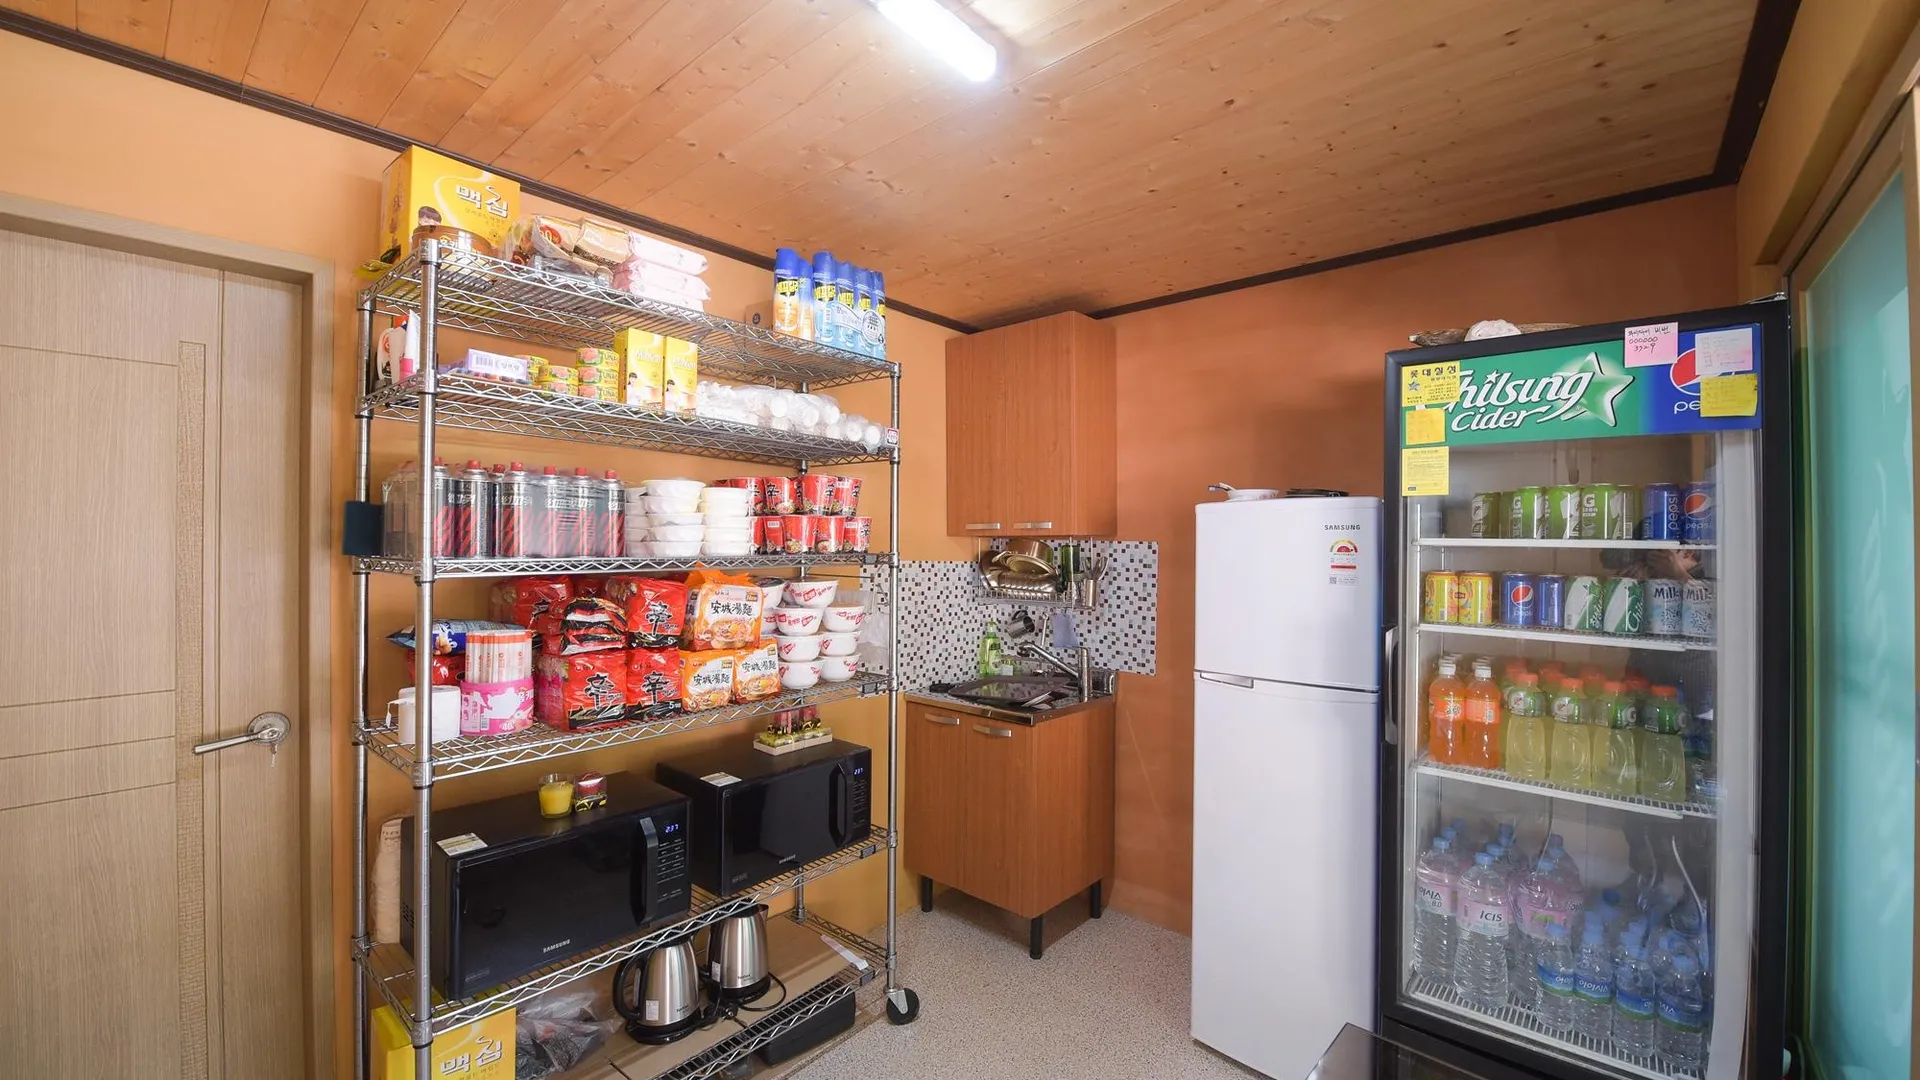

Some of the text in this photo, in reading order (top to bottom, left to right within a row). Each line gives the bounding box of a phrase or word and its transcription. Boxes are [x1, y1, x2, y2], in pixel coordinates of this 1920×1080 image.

[456, 186, 509, 218] 맥심
[1441, 369, 1595, 424] hilsung
[1479, 910, 1503, 923] ICIS
[543, 938, 571, 954] SAMSUNG
[440, 1036, 502, 1076] 맥심
